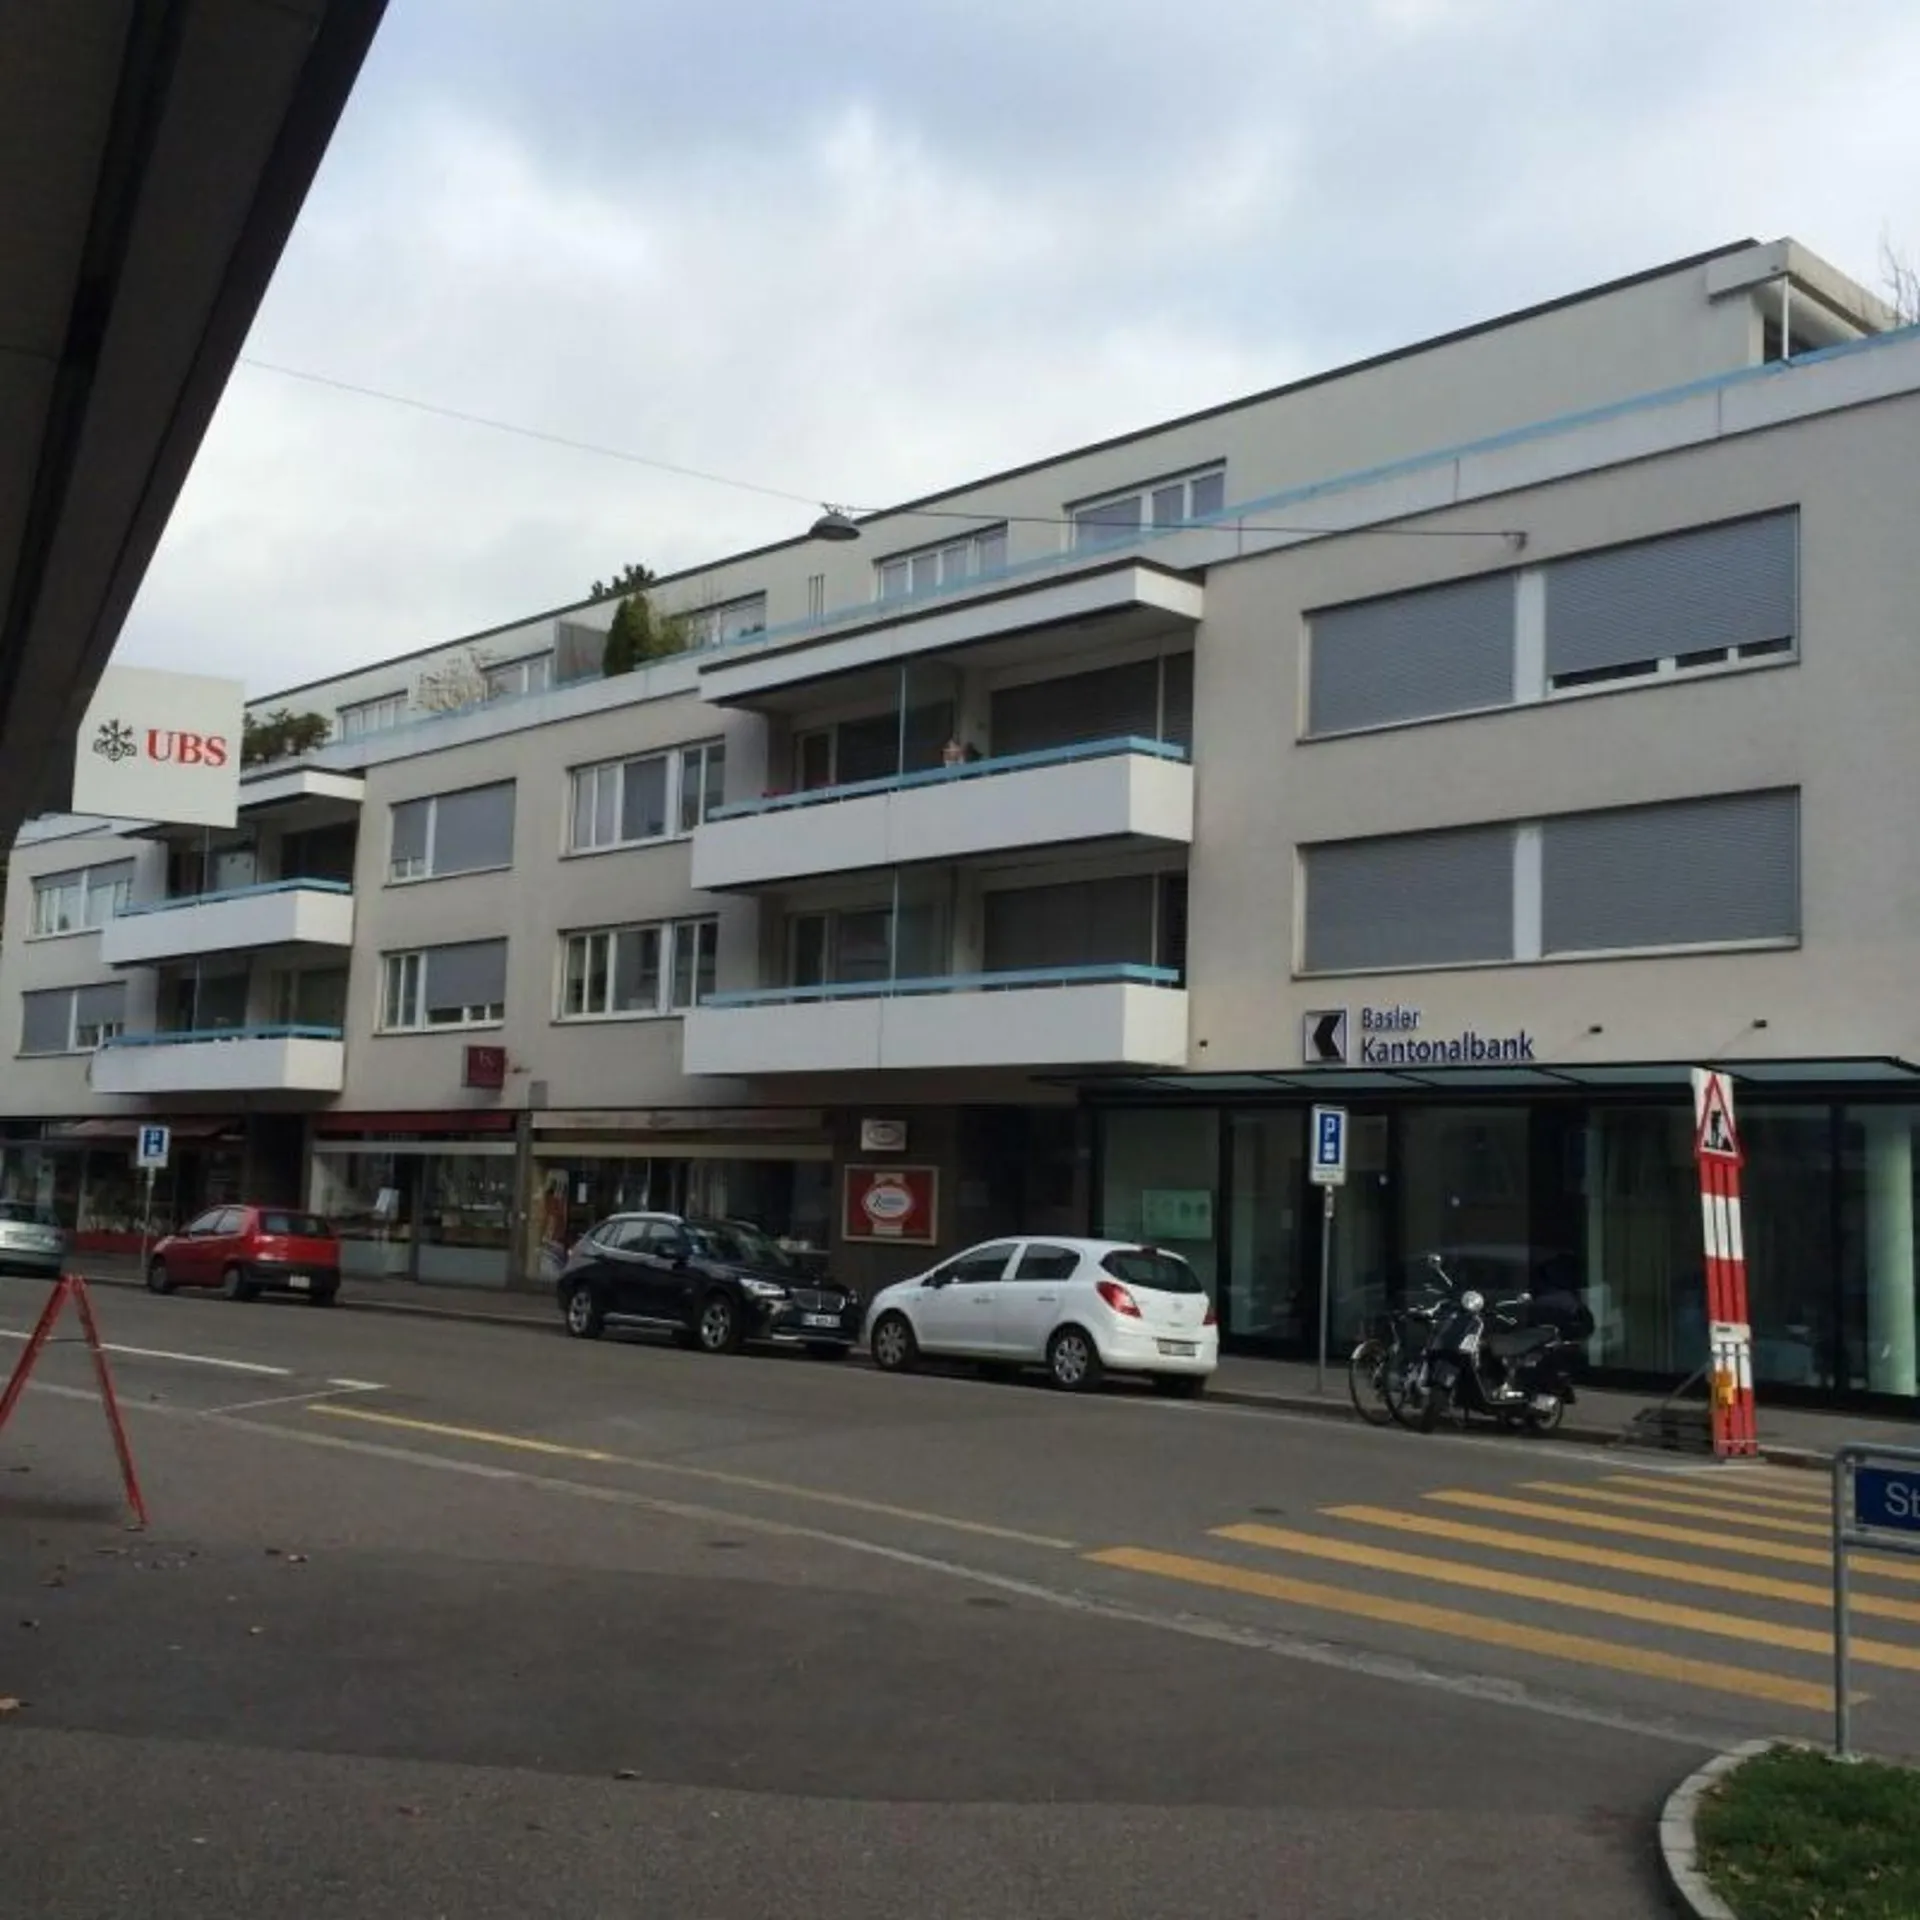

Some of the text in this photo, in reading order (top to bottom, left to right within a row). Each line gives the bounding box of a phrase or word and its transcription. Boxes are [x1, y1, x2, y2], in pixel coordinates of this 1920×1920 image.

[147, 729, 228, 767] UBS
[1362, 1006, 1420, 1030] Basler
[1362, 1030, 1534, 1063] Kantonalbank
[1324, 1117, 1336, 1142] P
